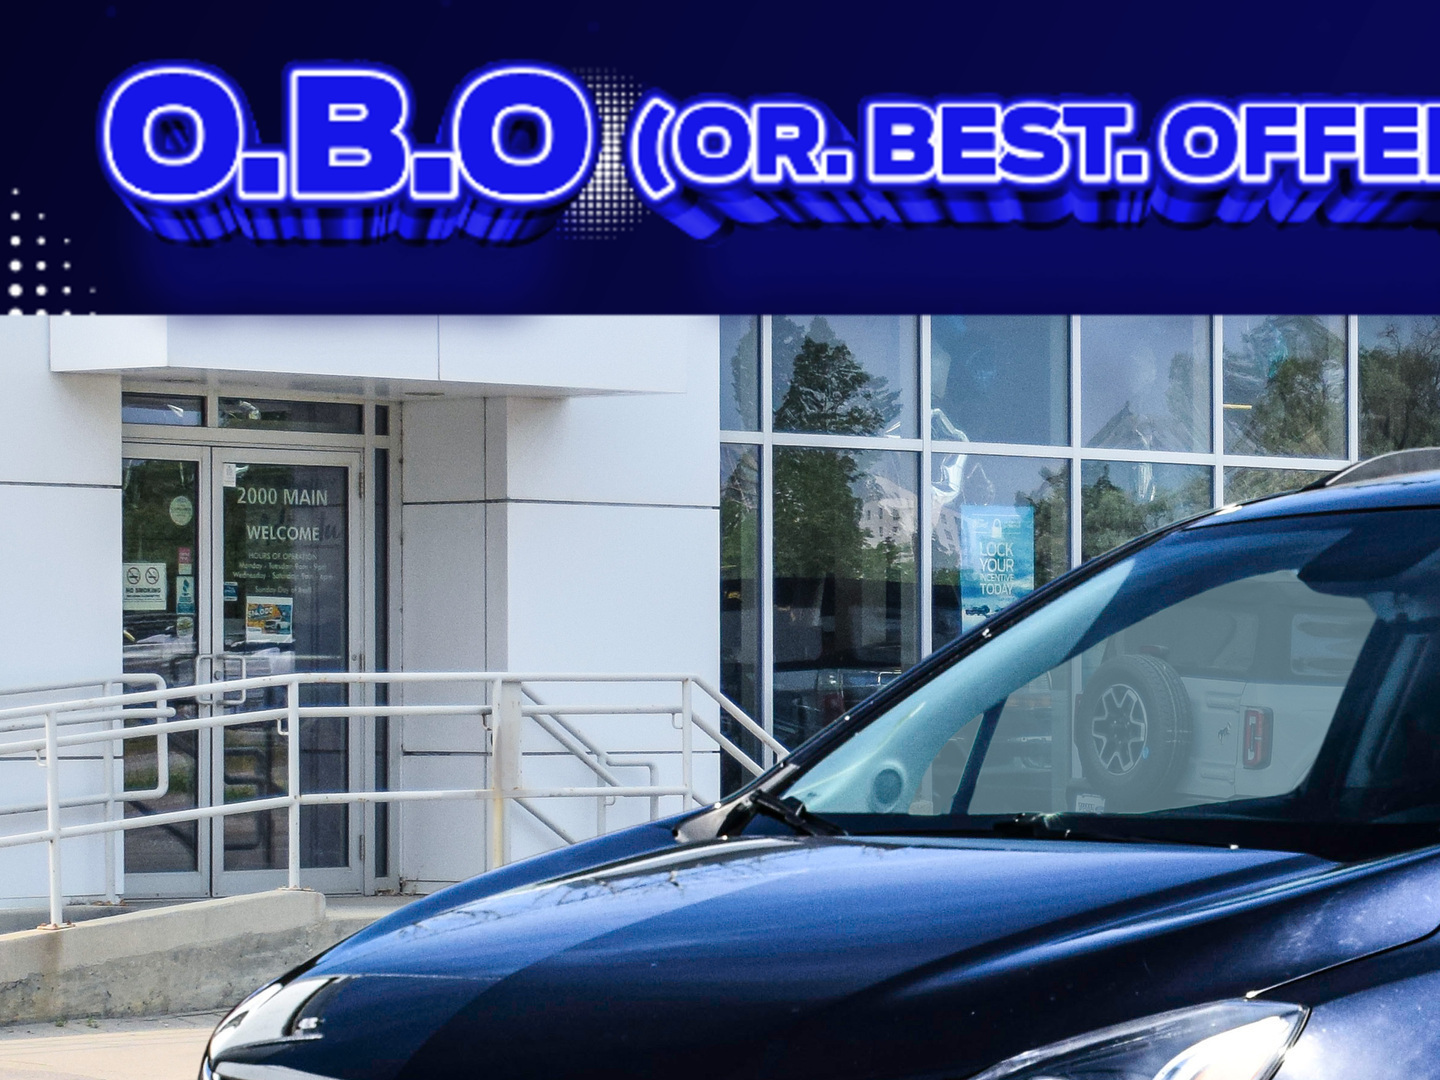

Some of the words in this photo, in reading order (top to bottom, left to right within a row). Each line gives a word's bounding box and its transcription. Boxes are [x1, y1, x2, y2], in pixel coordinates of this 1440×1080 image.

[237, 487, 278, 504] 2000
[283, 489, 328, 505] MAIN
[246, 525, 320, 541] WELCOME
[980, 542, 1014, 557] LOCK
[980, 558, 1014, 572] YOUR
[980, 583, 1013, 595] TODAY
